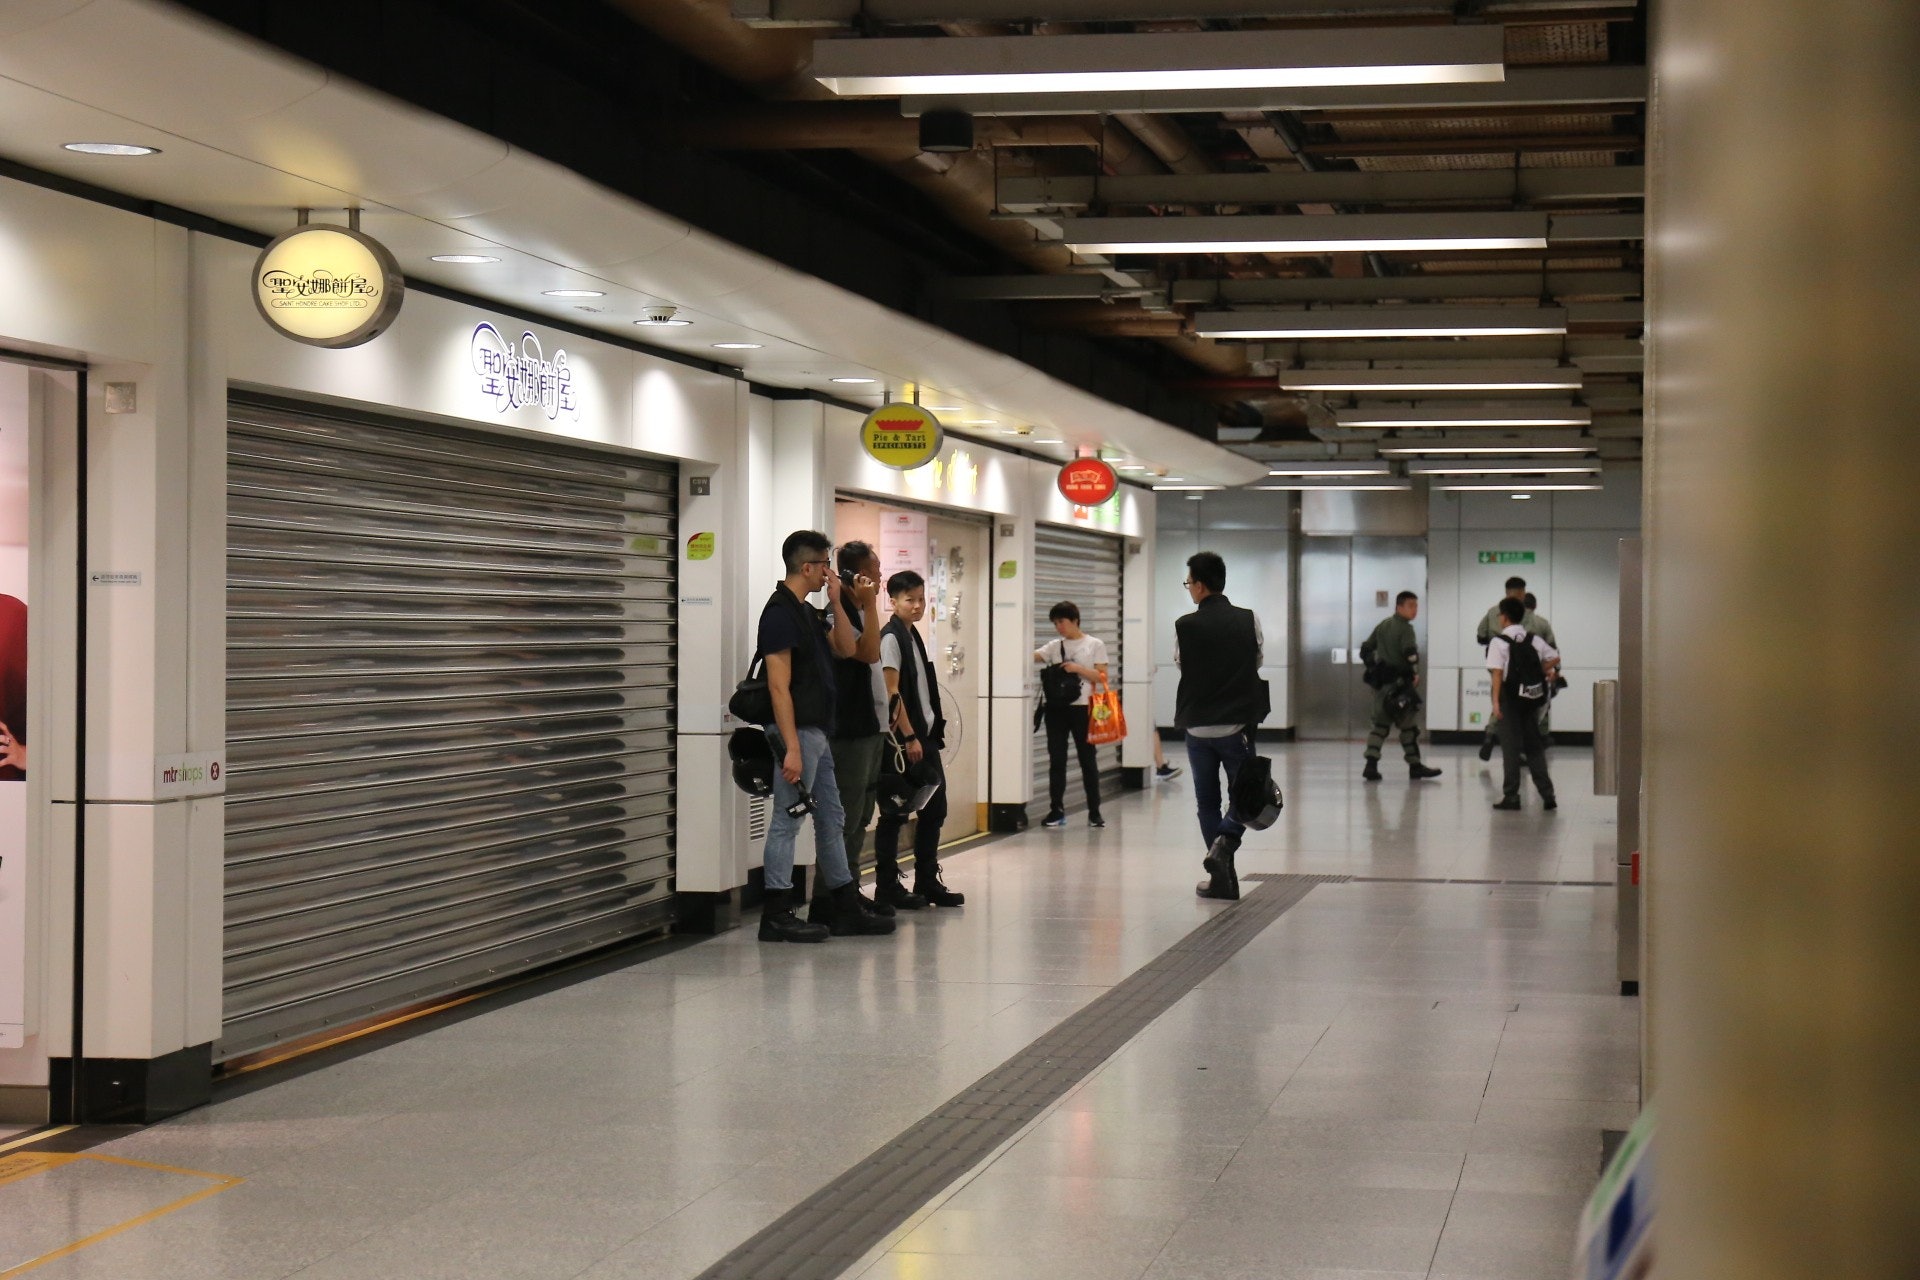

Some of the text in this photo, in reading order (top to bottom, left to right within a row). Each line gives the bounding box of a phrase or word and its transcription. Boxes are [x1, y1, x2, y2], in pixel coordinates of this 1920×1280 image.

[262, 269, 379, 299] 聖安娜餅屋
[471, 321, 581, 423] 聖安娜餅屋
[873, 433, 926, 441] Pie & Tart
